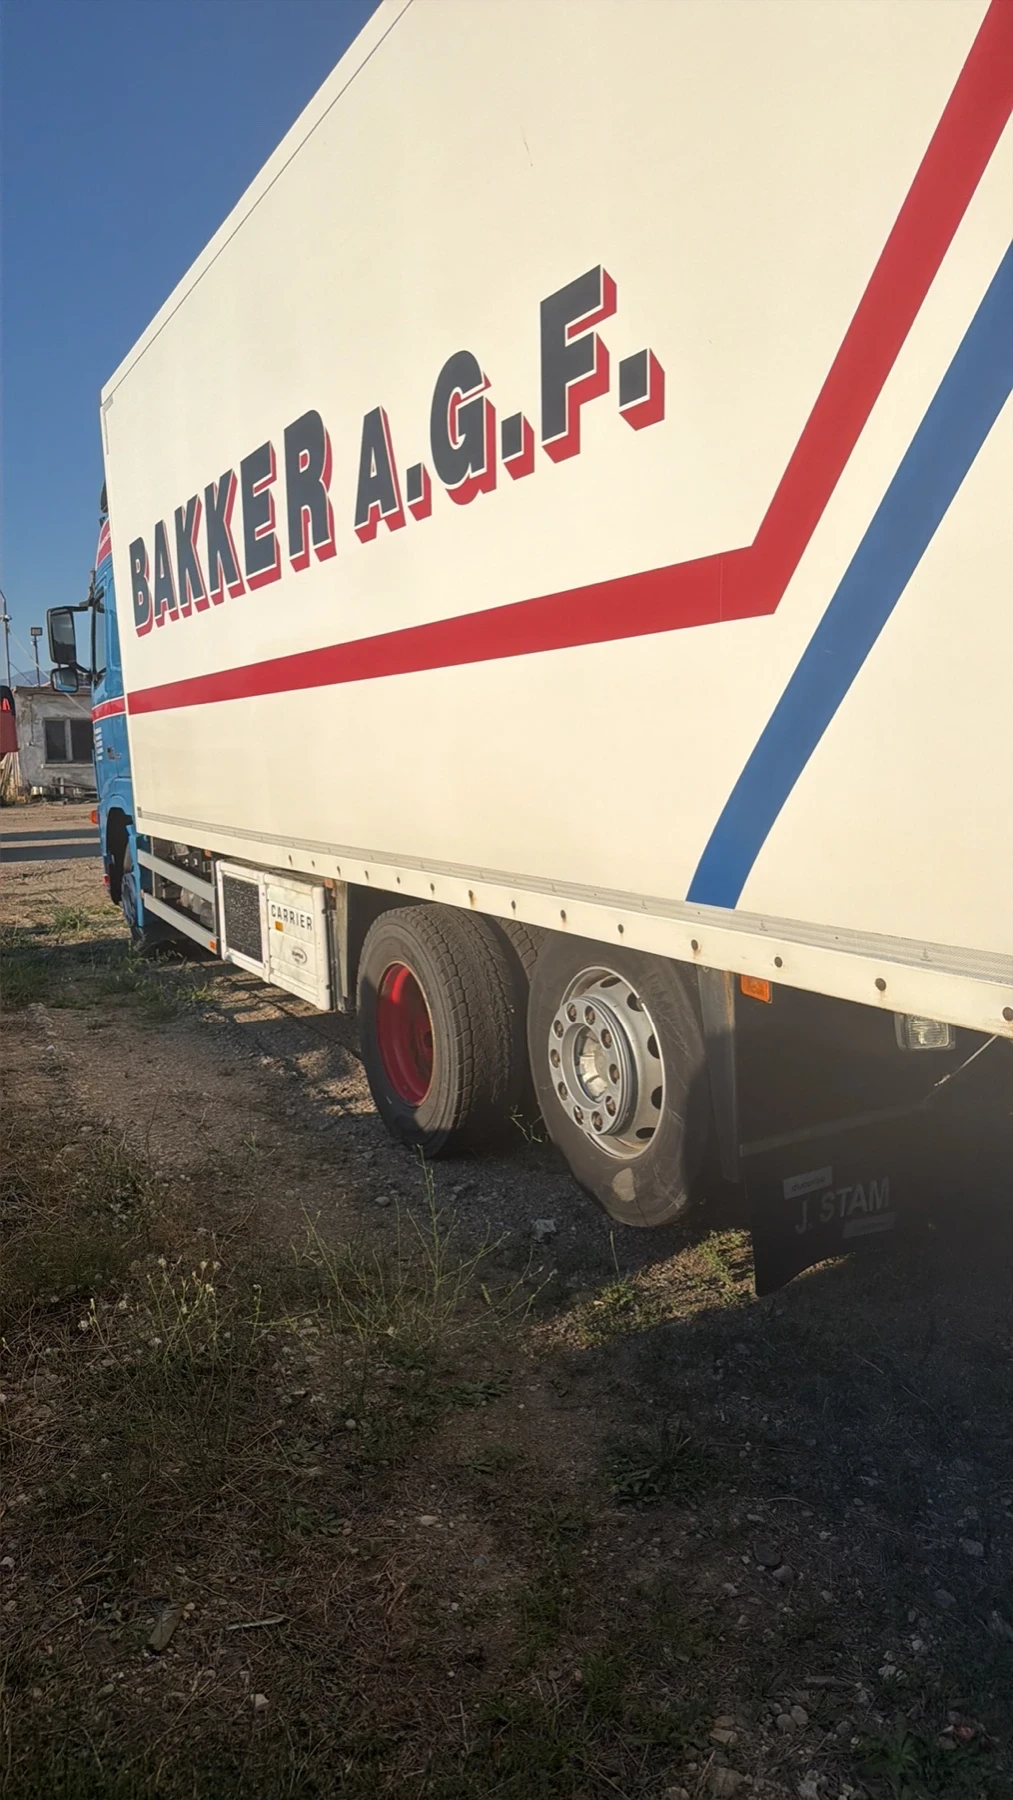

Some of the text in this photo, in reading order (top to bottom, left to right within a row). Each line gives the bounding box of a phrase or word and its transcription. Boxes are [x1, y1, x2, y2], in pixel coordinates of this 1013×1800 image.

[129, 264, 665, 637] BAKKER A.G.F.
[271, 904, 313, 931] CARRIER
[819, 1175, 890, 1223] STAM
